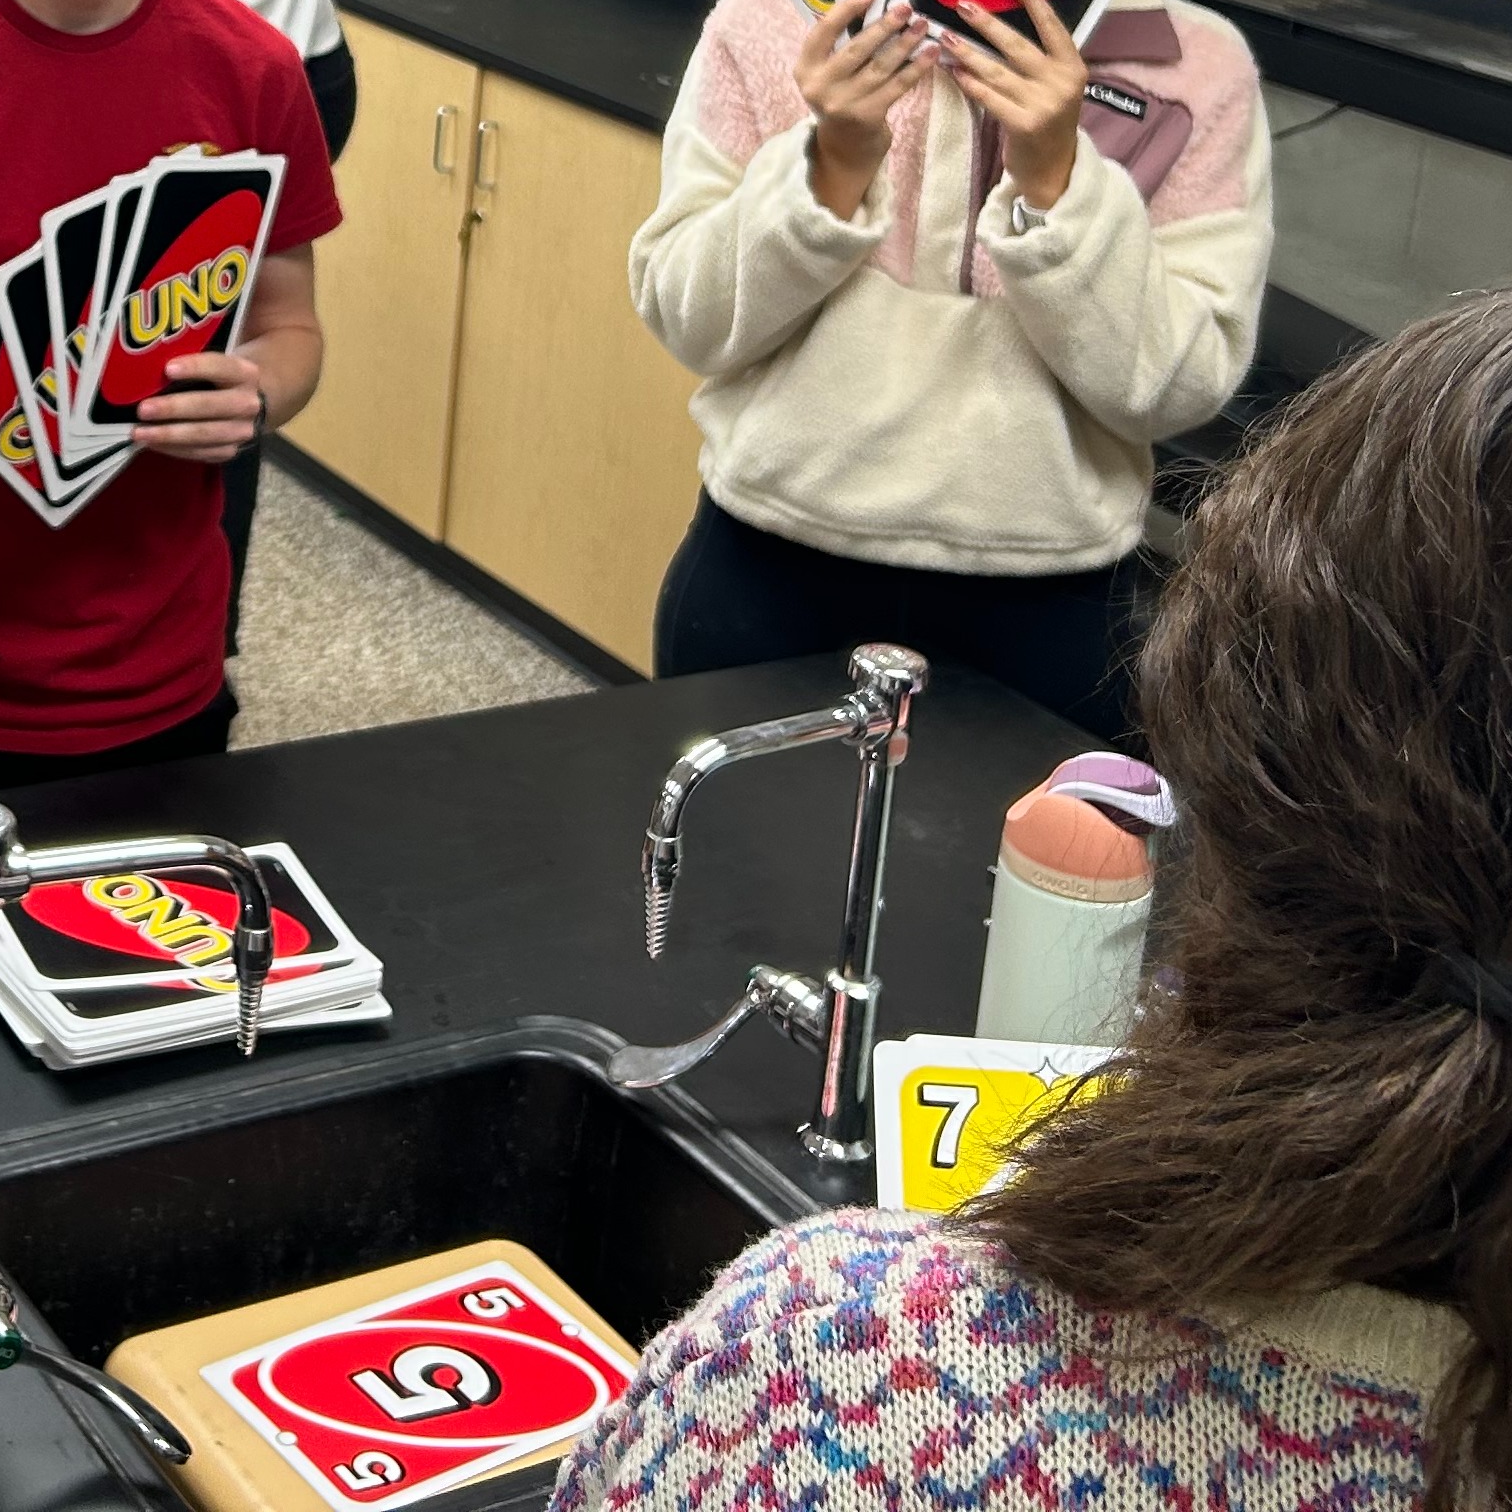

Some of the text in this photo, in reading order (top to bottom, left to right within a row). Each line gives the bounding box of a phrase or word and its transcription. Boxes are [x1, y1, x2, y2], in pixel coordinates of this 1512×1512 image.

[118, 244, 252, 355] UNO
[82, 871, 235, 970] UNO
[916, 1082, 981, 1170] 7
[458, 1286, 529, 1319] 5
[348, 1341, 502, 1424] 5
[331, 1449, 406, 1492] 5
